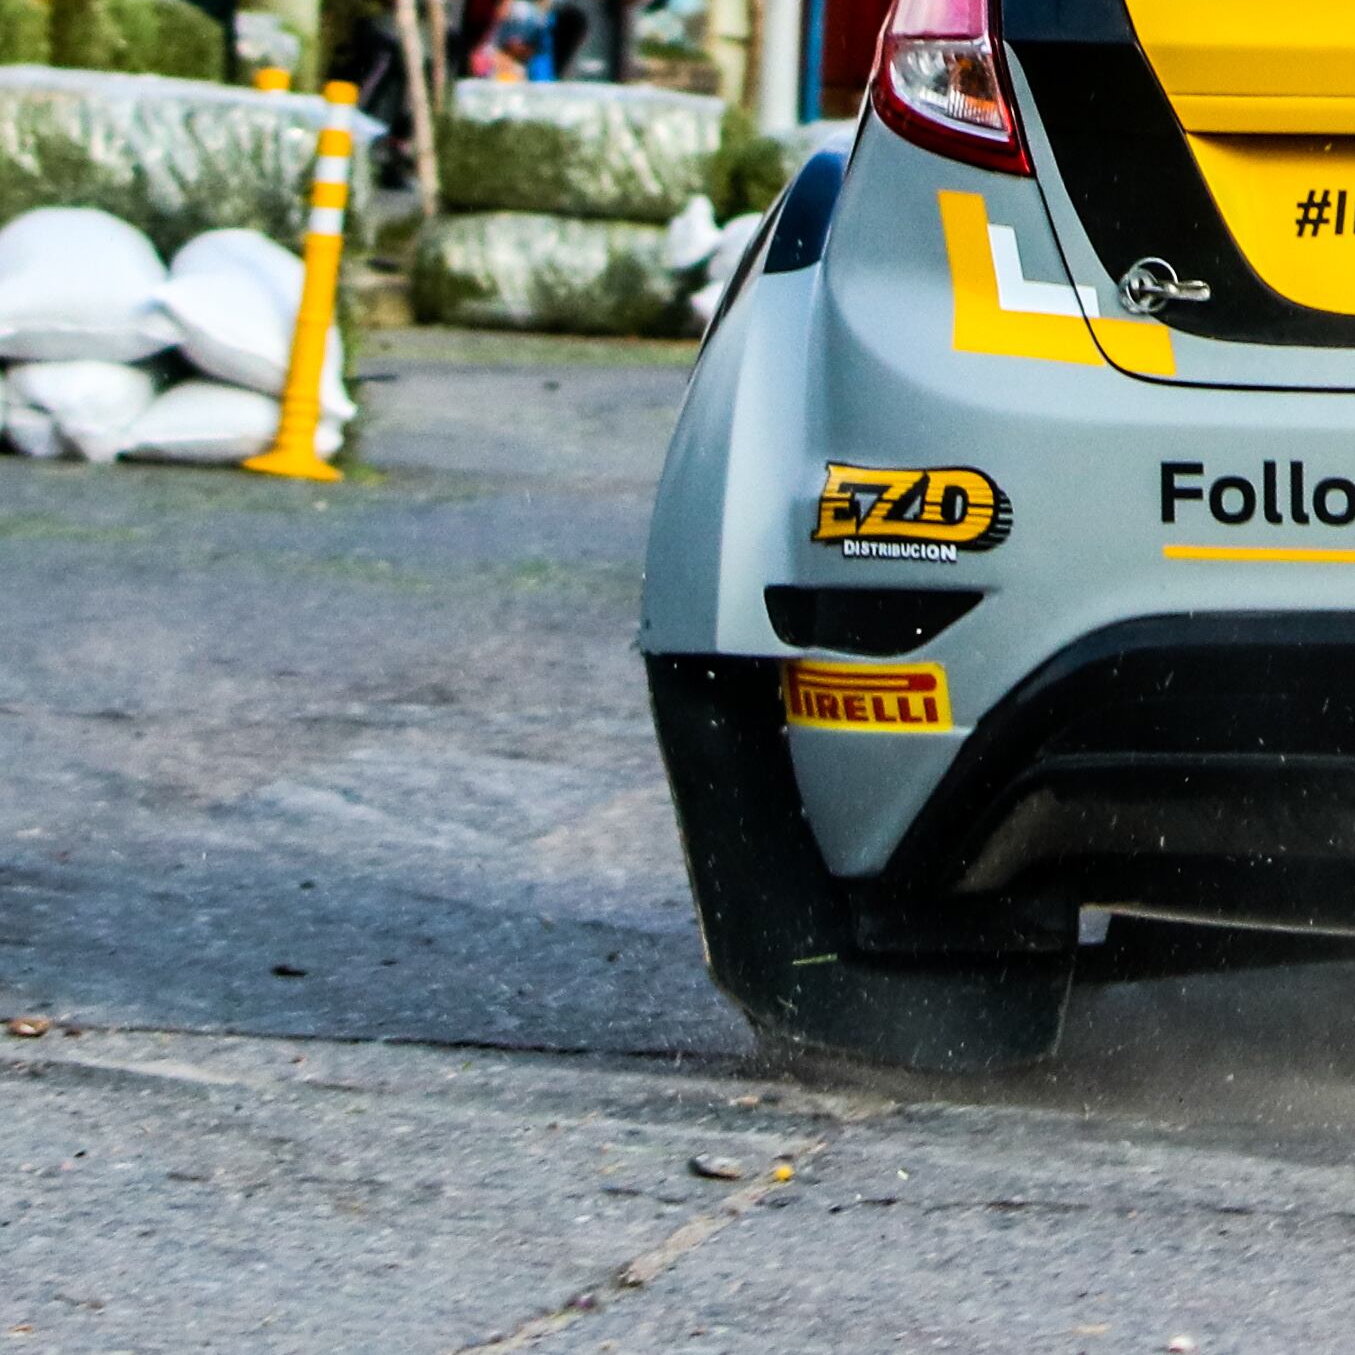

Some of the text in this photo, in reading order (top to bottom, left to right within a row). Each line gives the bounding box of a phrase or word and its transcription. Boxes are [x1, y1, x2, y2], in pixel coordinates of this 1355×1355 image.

[811, 461, 1000, 547] EZD
[843, 539, 958, 563] DISTRIBUCION
[788, 666, 939, 724] PIRELLI
